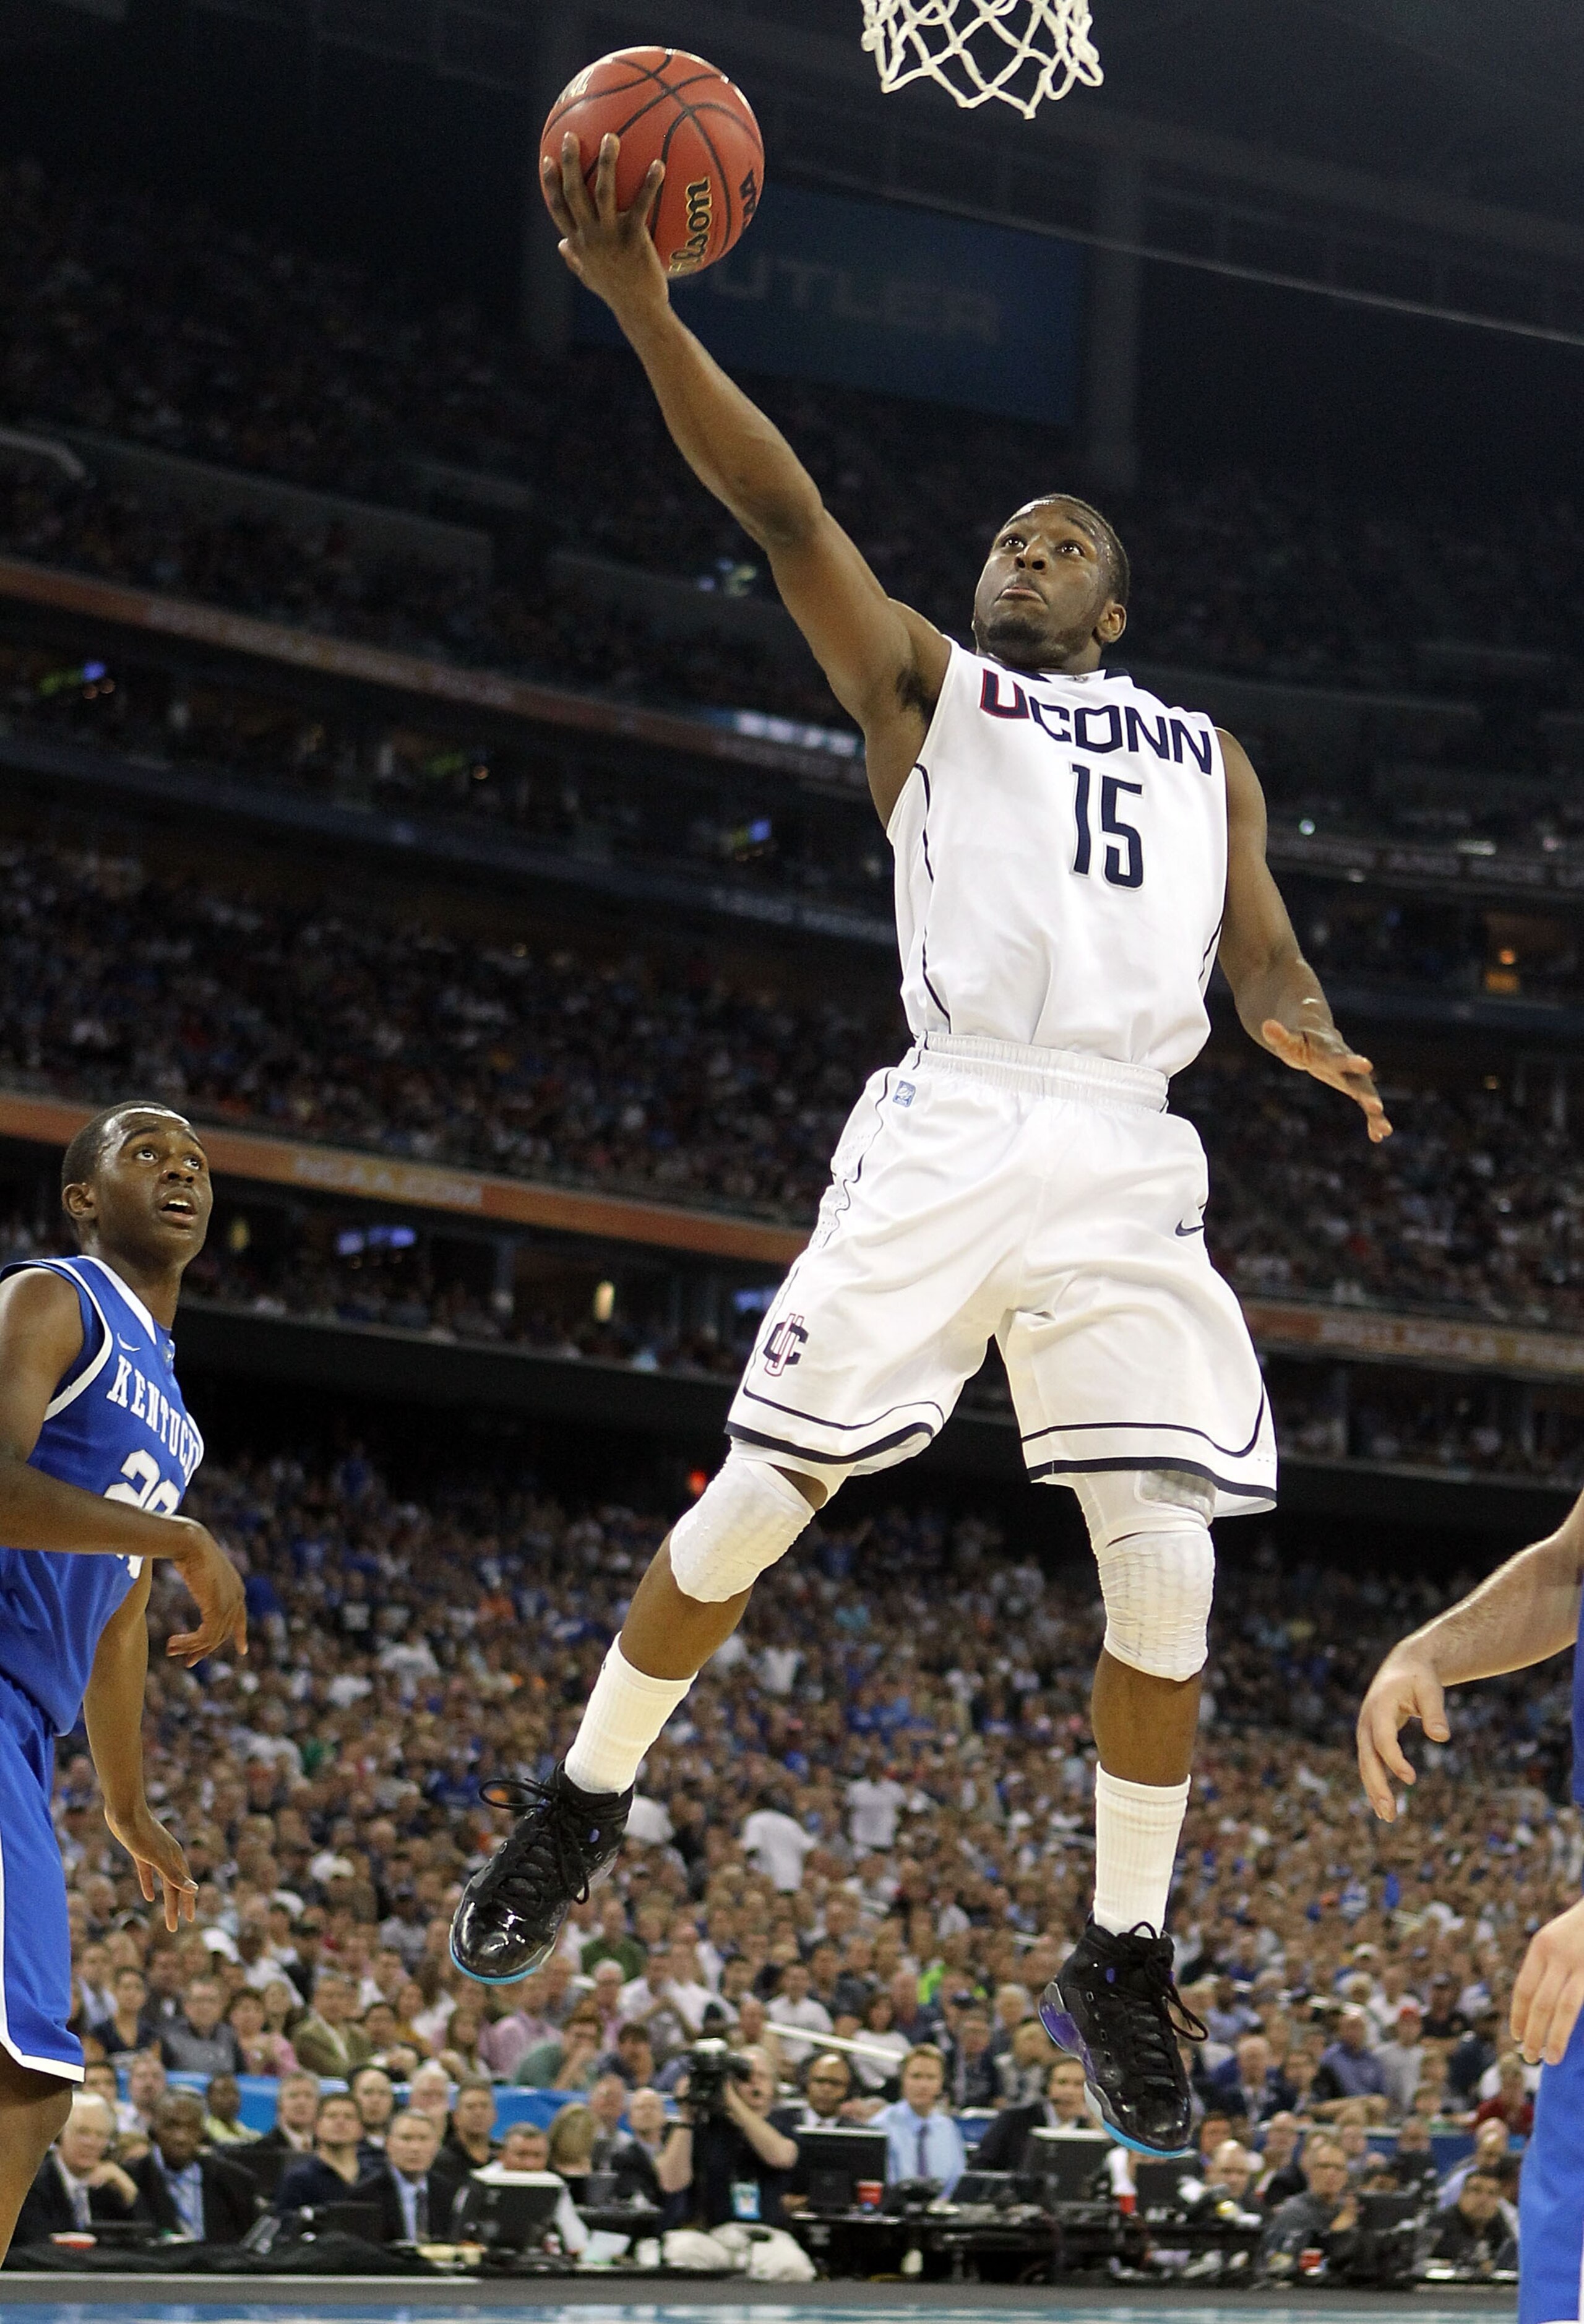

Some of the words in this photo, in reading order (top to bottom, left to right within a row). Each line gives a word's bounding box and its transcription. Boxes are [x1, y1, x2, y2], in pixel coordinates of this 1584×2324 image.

[678, 252, 1001, 343] UTLER
[979, 668, 1212, 776] UCONN
[1069, 762, 1144, 891] 15
